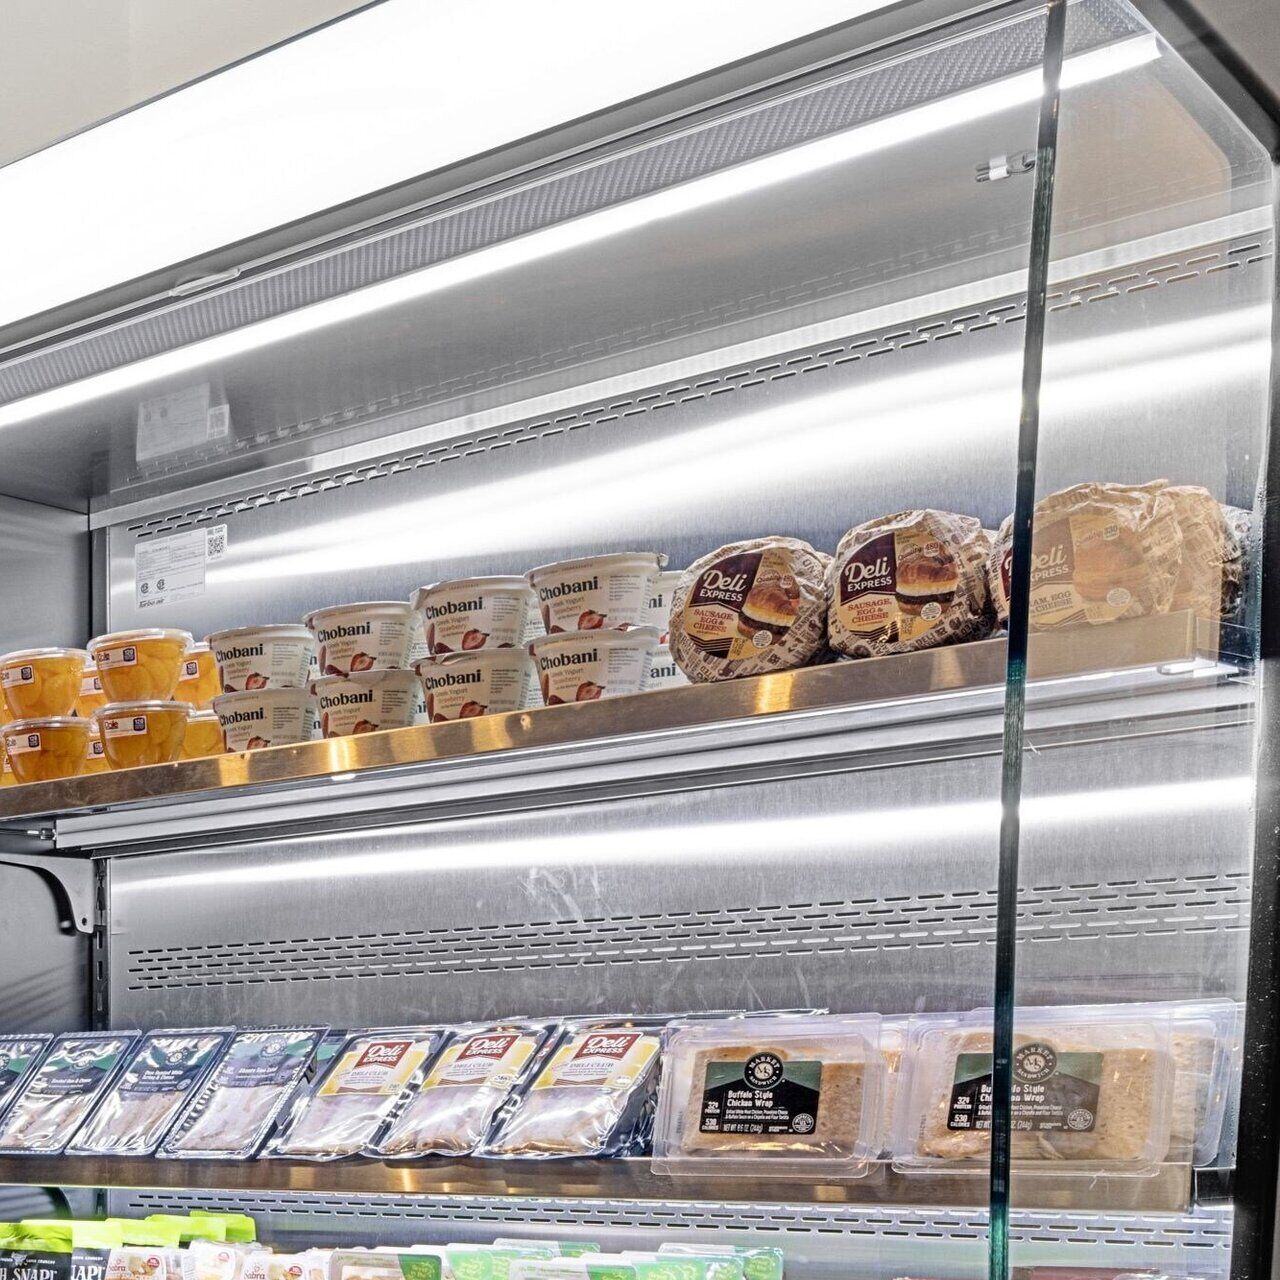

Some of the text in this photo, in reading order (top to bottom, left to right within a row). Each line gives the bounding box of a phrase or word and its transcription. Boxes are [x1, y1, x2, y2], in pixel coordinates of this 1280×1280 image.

[845, 556, 891, 583] Deli
[703, 569, 747, 592] Deli
[847, 576, 892, 592] EXPRESS
[540, 577, 599, 602] Chobani
[699, 589, 743, 602] EXPRESS
[426, 596, 483, 620] Chobani
[856, 607, 877, 617] EGG
[851, 612, 889, 624] CHEESE
[317, 621, 371, 643] Chobani
[540, 648, 598, 671] Chobani
[320, 689, 373, 709] Chobani
[470, 1036, 510, 1052] Deli
[582, 1046, 625, 1057] EXPRESS
[586, 1036, 630, 1051] Deli
[464, 1047, 504, 1057] EXPRESS
[754, 1089, 774, 1100] Style
[726, 1098, 774, 1108] Chicken Wrap
